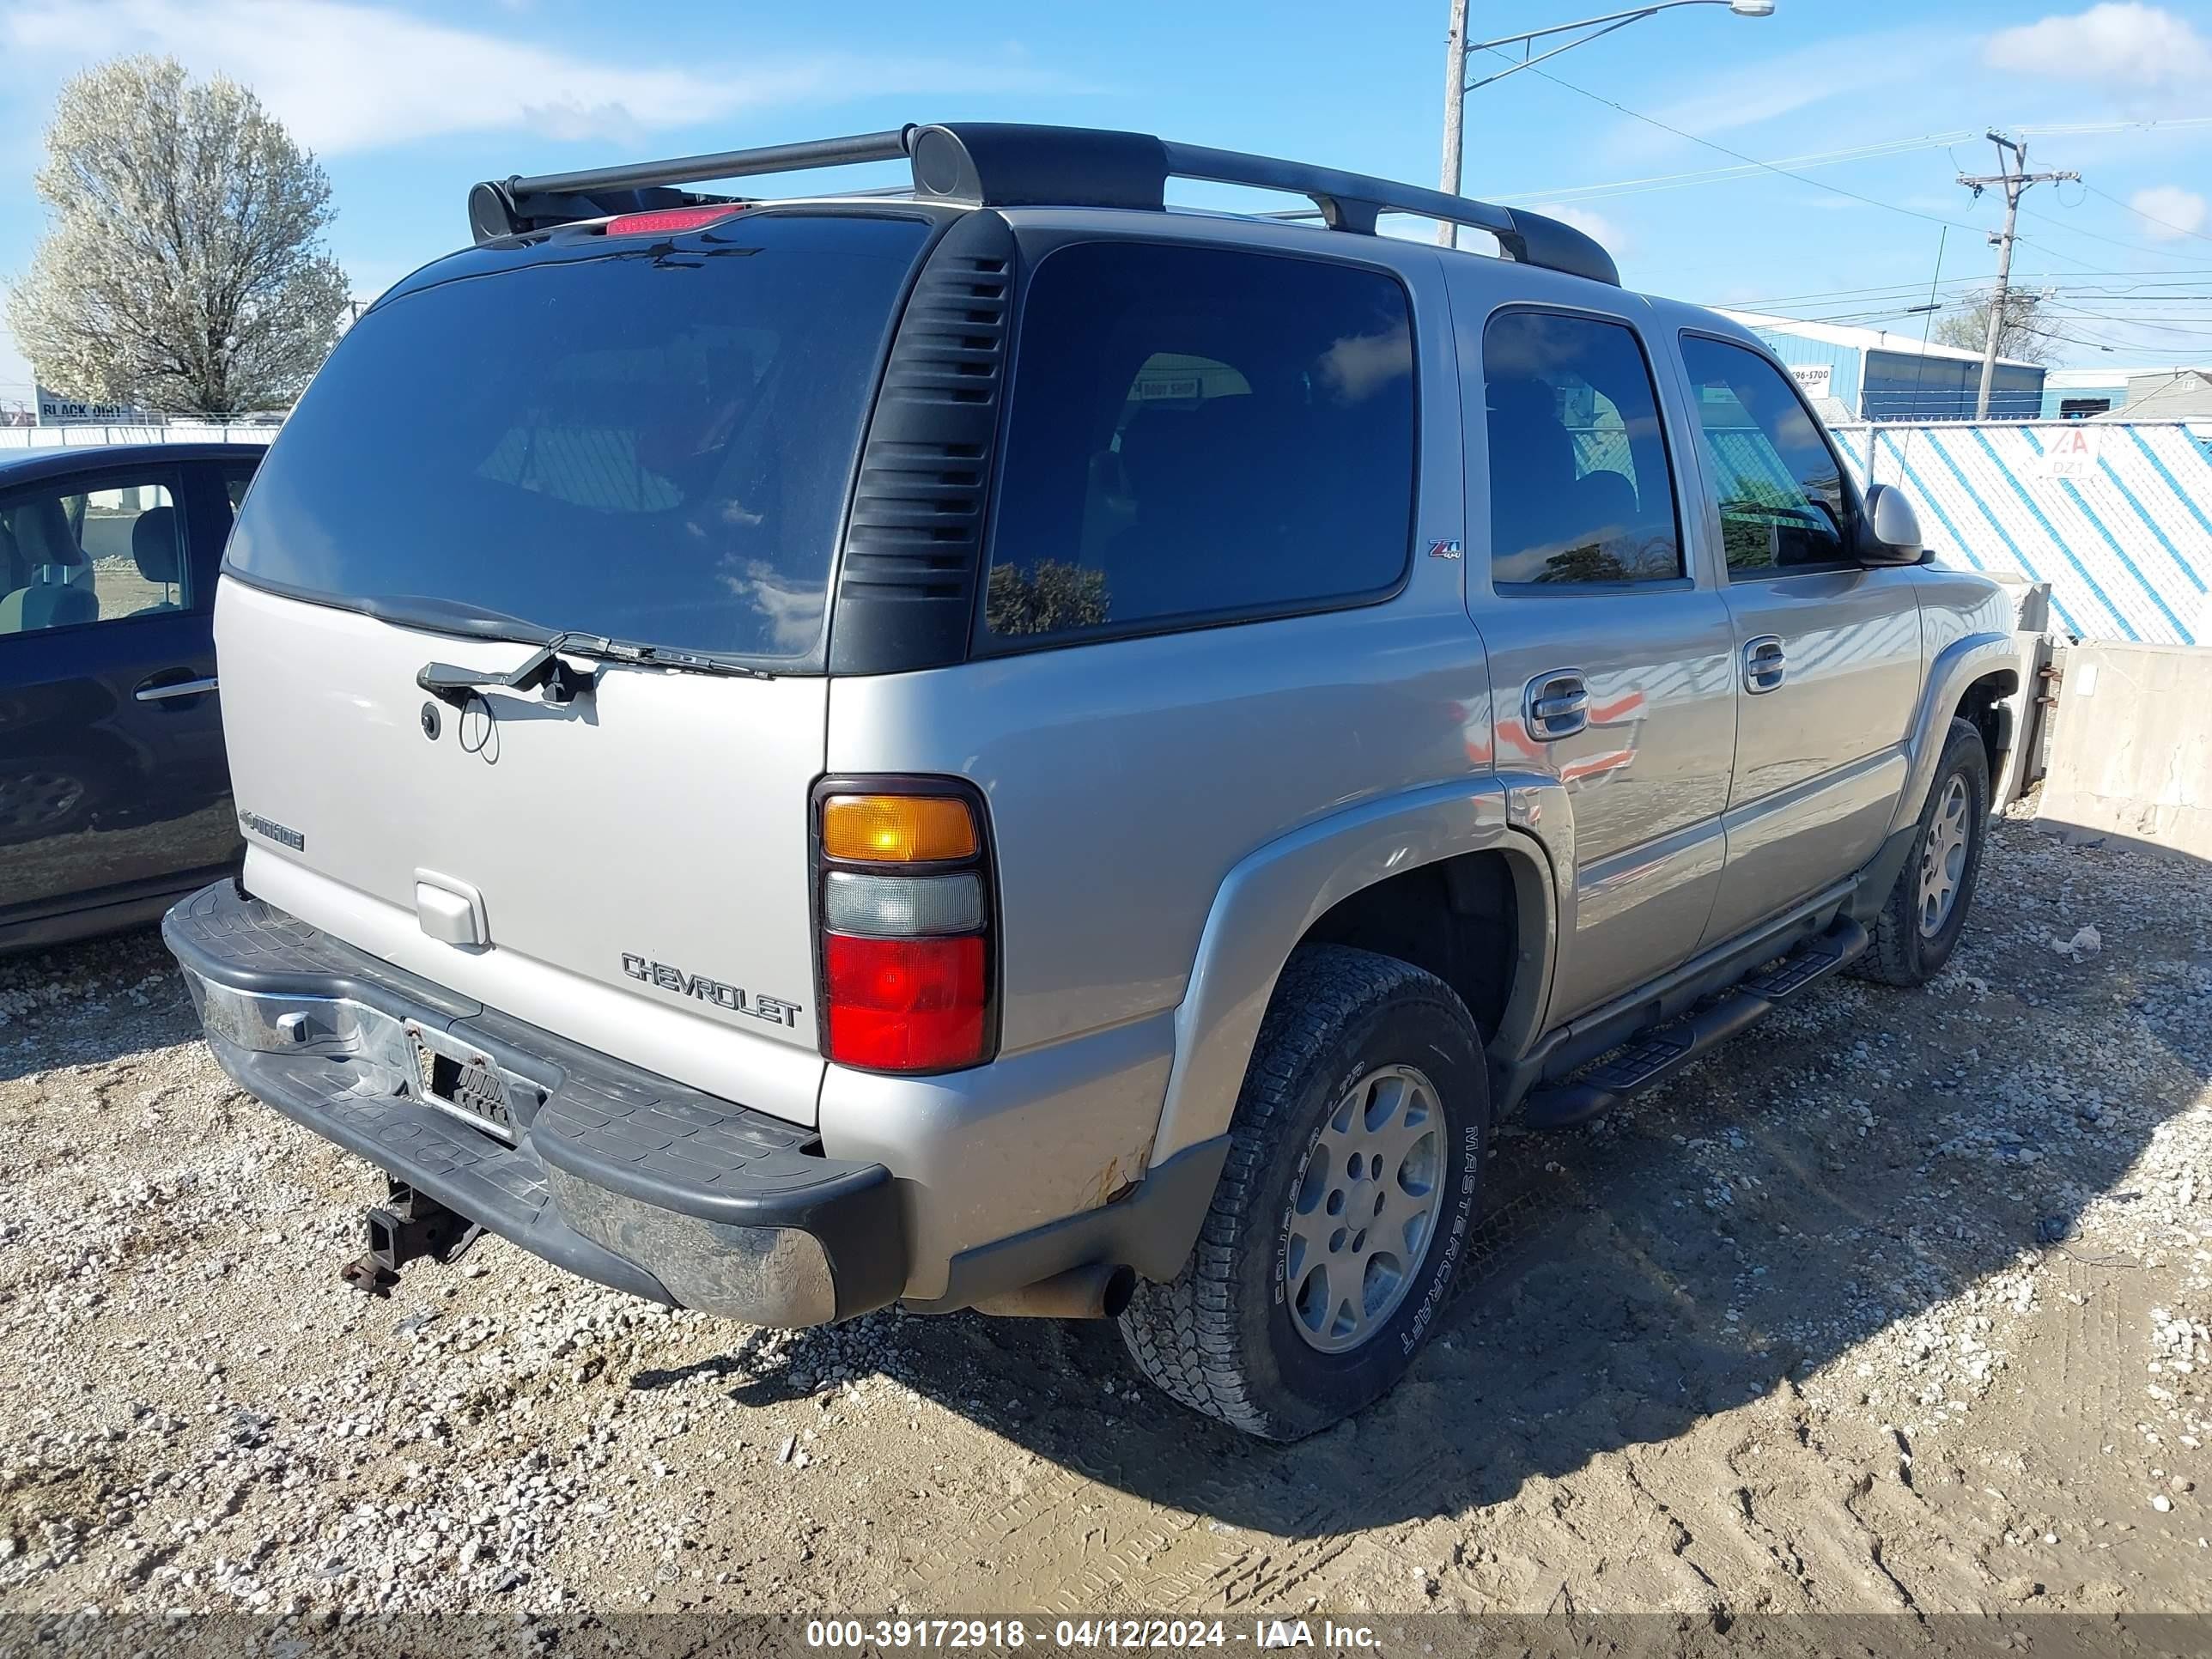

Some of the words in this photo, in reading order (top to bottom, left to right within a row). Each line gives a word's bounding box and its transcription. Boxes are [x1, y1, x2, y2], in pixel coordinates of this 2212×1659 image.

[1792, 370, 1829, 380] 96-5700
[43, 404, 88, 417] BLACK
[2053, 461, 2083, 474] DZ1
[620, 951, 803, 1029] CHEVROLET
[1401, 1125, 1479, 1356] MASTERCRAFT
